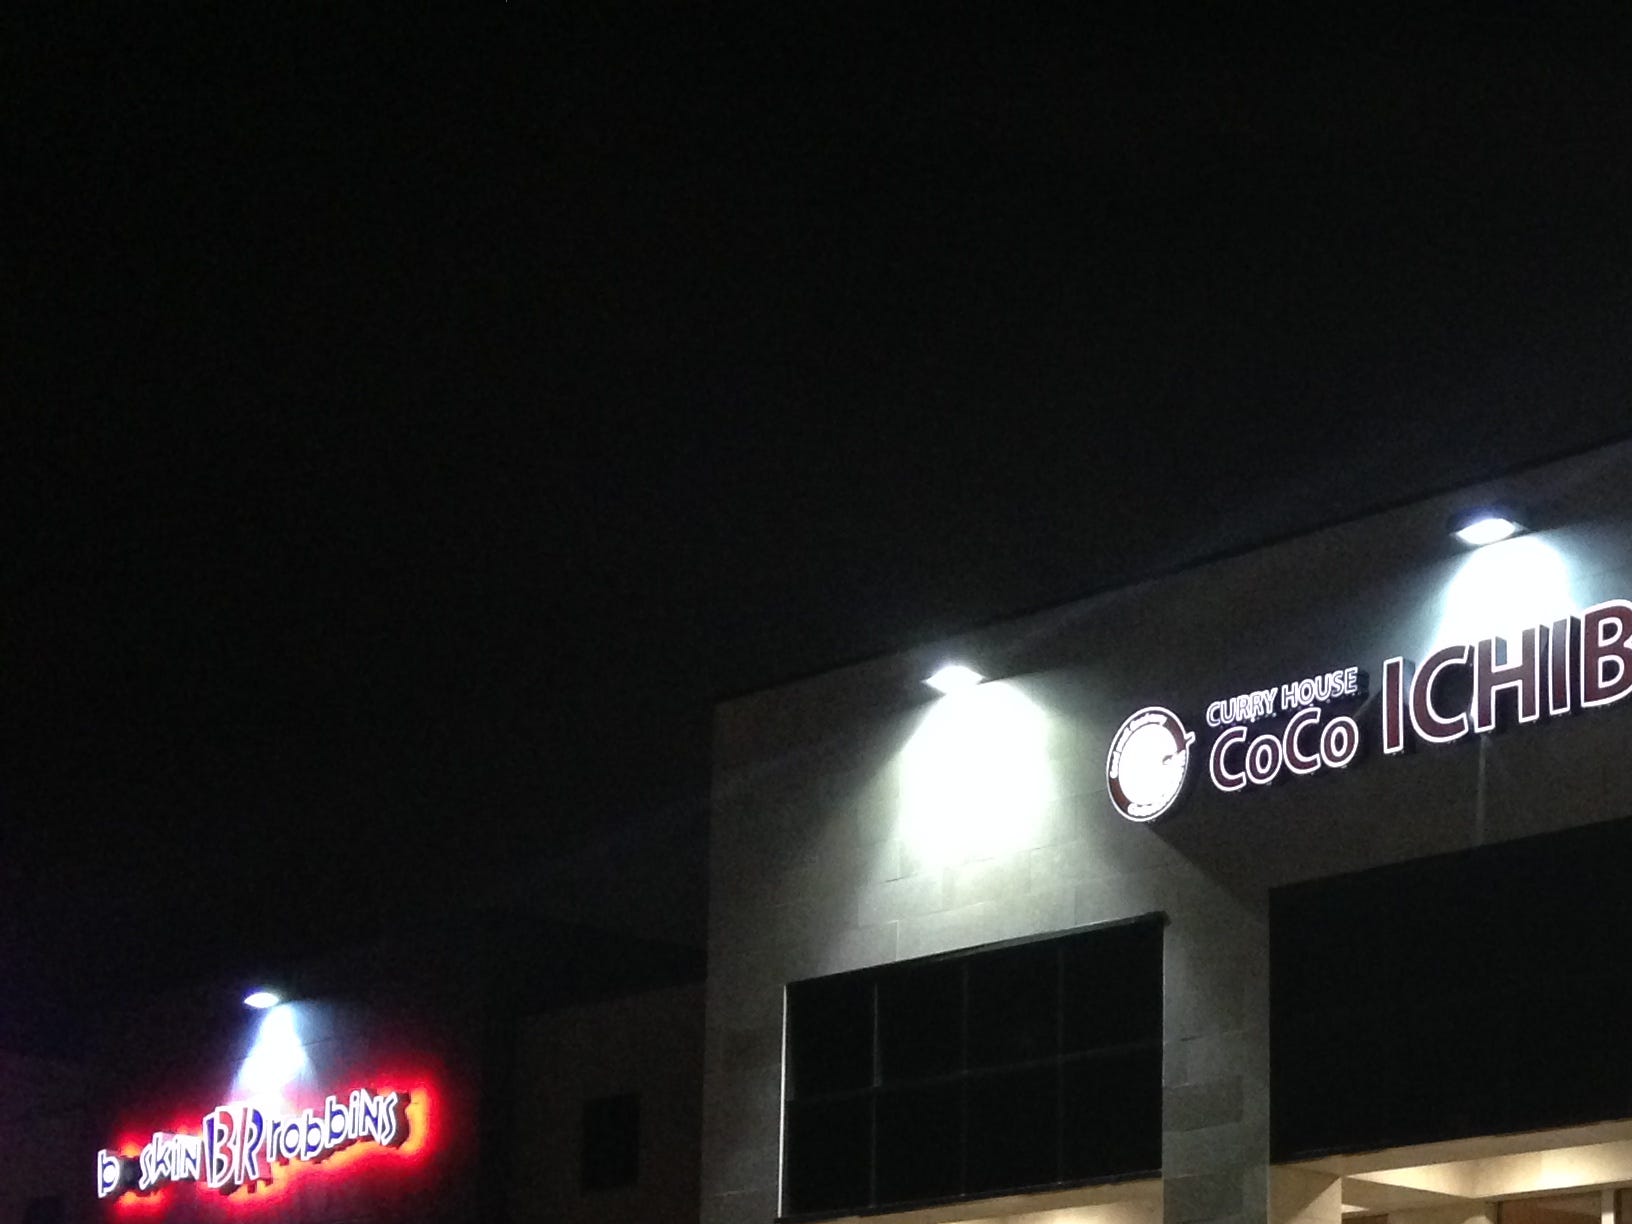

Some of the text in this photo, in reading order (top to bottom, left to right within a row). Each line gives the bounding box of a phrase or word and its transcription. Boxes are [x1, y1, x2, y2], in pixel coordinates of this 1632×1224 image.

[1206, 667, 1358, 727] CURRY HOUSE
[1209, 707, 1360, 792] CoCo
[97, 1131, 201, 1198] bskin
